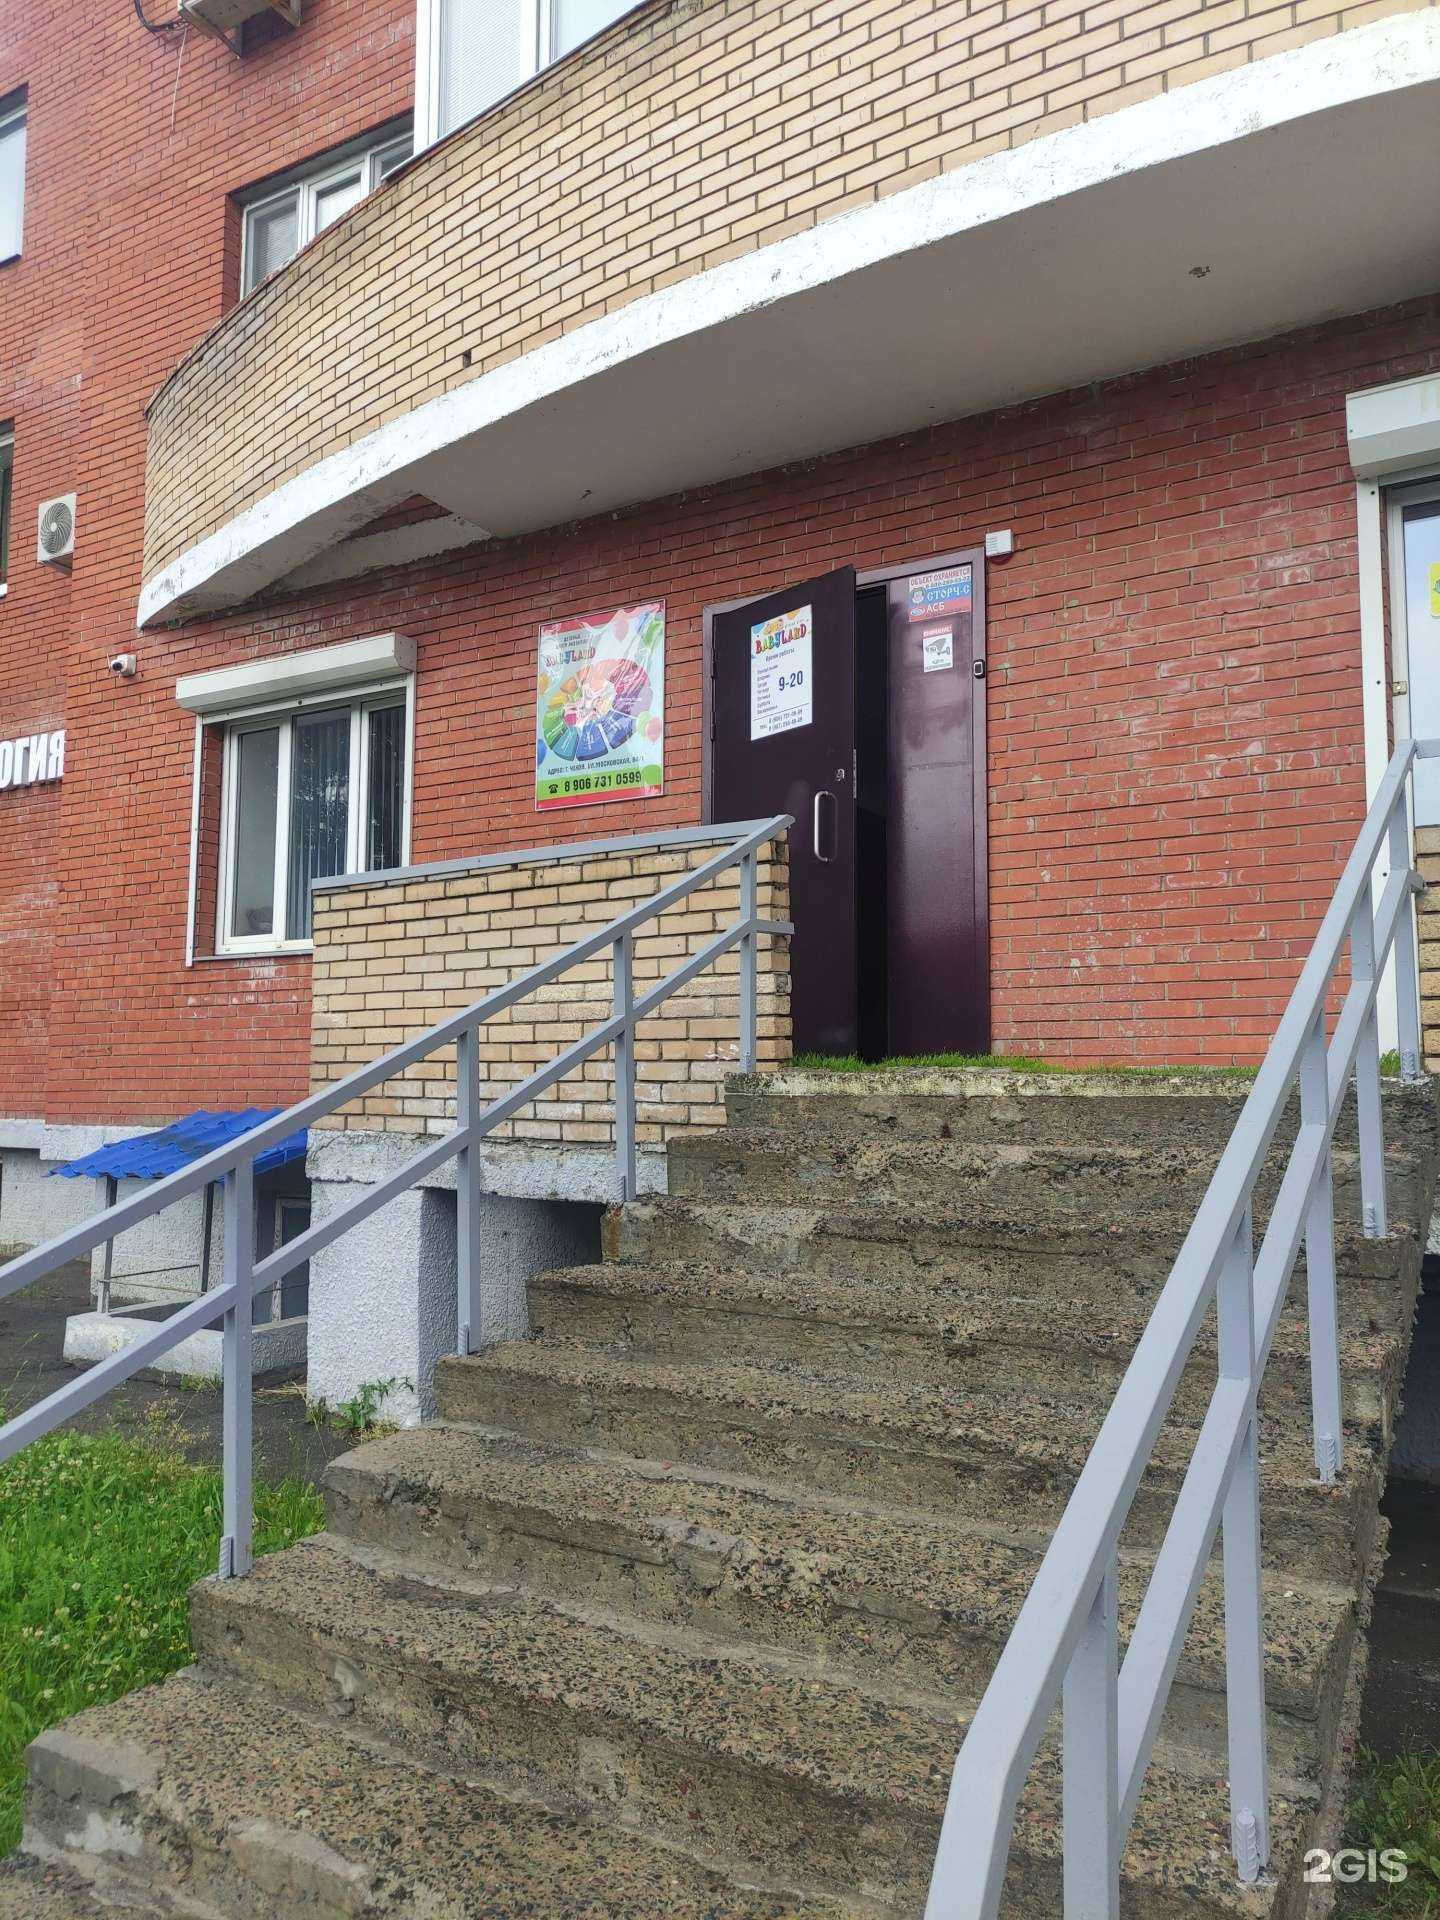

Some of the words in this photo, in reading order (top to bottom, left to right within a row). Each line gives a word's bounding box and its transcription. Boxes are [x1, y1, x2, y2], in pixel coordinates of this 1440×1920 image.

[927, 602, 945, 613] АСБ
[755, 623, 807, 654] BABYLAND
[779, 670, 803, 691] 9-20
[564, 780, 570, 792] 8
[573, 778, 591, 791] 906
[594, 775, 612, 788] 731
[616, 771, 642, 785] 0599
